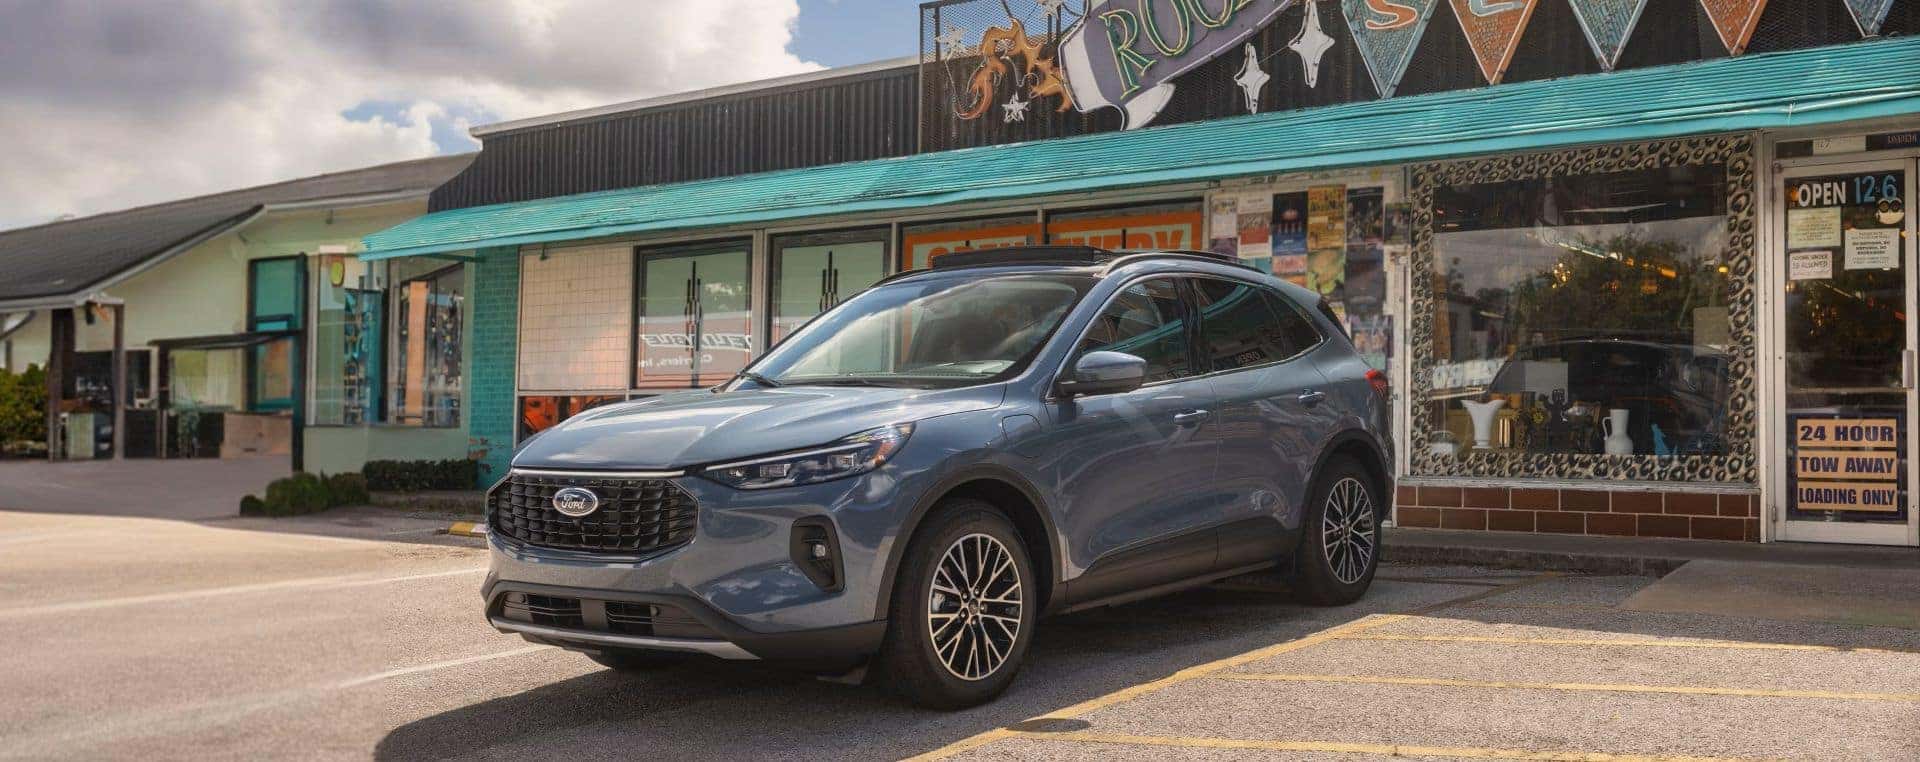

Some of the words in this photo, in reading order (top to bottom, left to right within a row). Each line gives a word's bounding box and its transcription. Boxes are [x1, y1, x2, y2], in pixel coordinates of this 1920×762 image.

[1798, 181, 1847, 207] OPEN
[1800, 425, 1826, 441] 24
[1834, 425, 1894, 441] HOUR
[1800, 456, 1839, 473] TOW
[1845, 457, 1895, 474] AWAY
[561, 493, 586, 510] Ford
[1799, 487, 1857, 505] LOADING
[1862, 489, 1895, 506] ONLY
